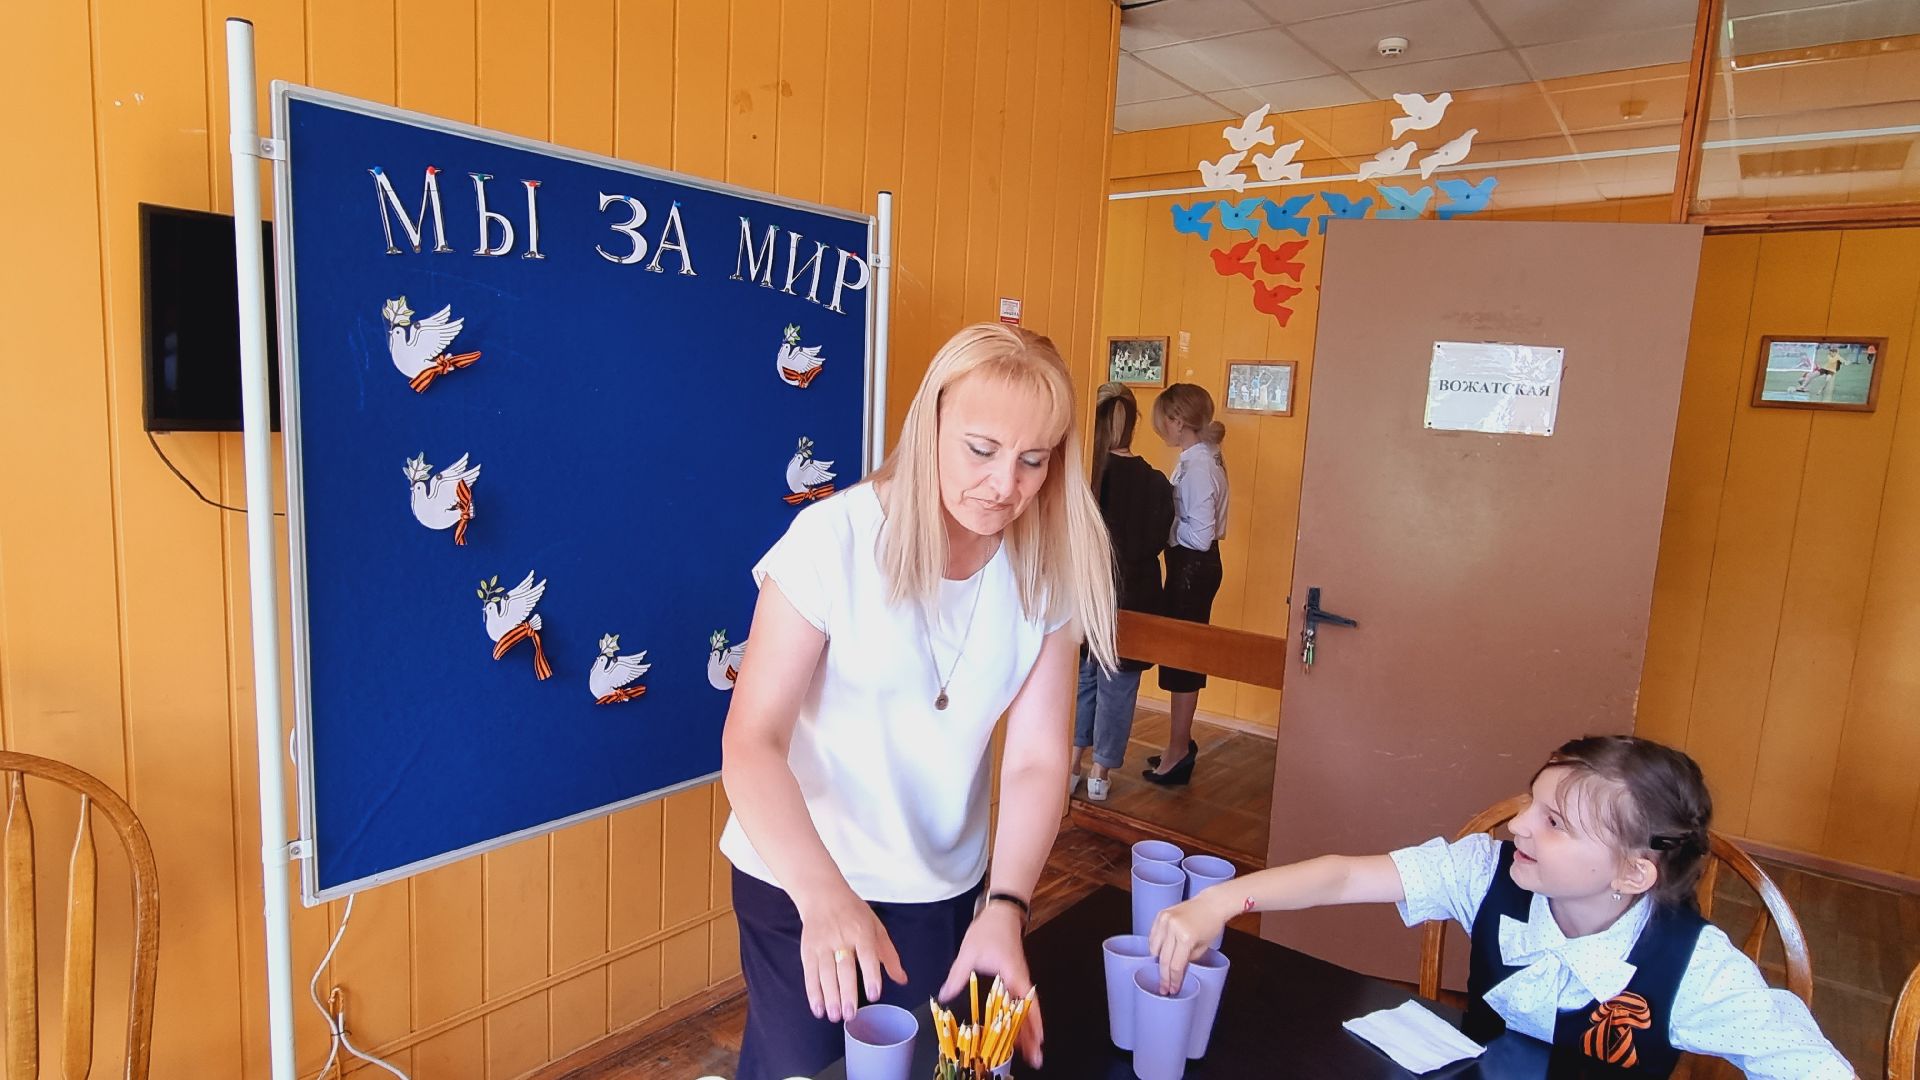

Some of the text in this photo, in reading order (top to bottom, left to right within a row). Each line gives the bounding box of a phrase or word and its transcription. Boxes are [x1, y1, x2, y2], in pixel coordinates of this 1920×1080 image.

[368, 167, 871, 314] МЫ ЗА МИР
[1438, 379, 1551, 397] ВОЖАТСКАЯ
